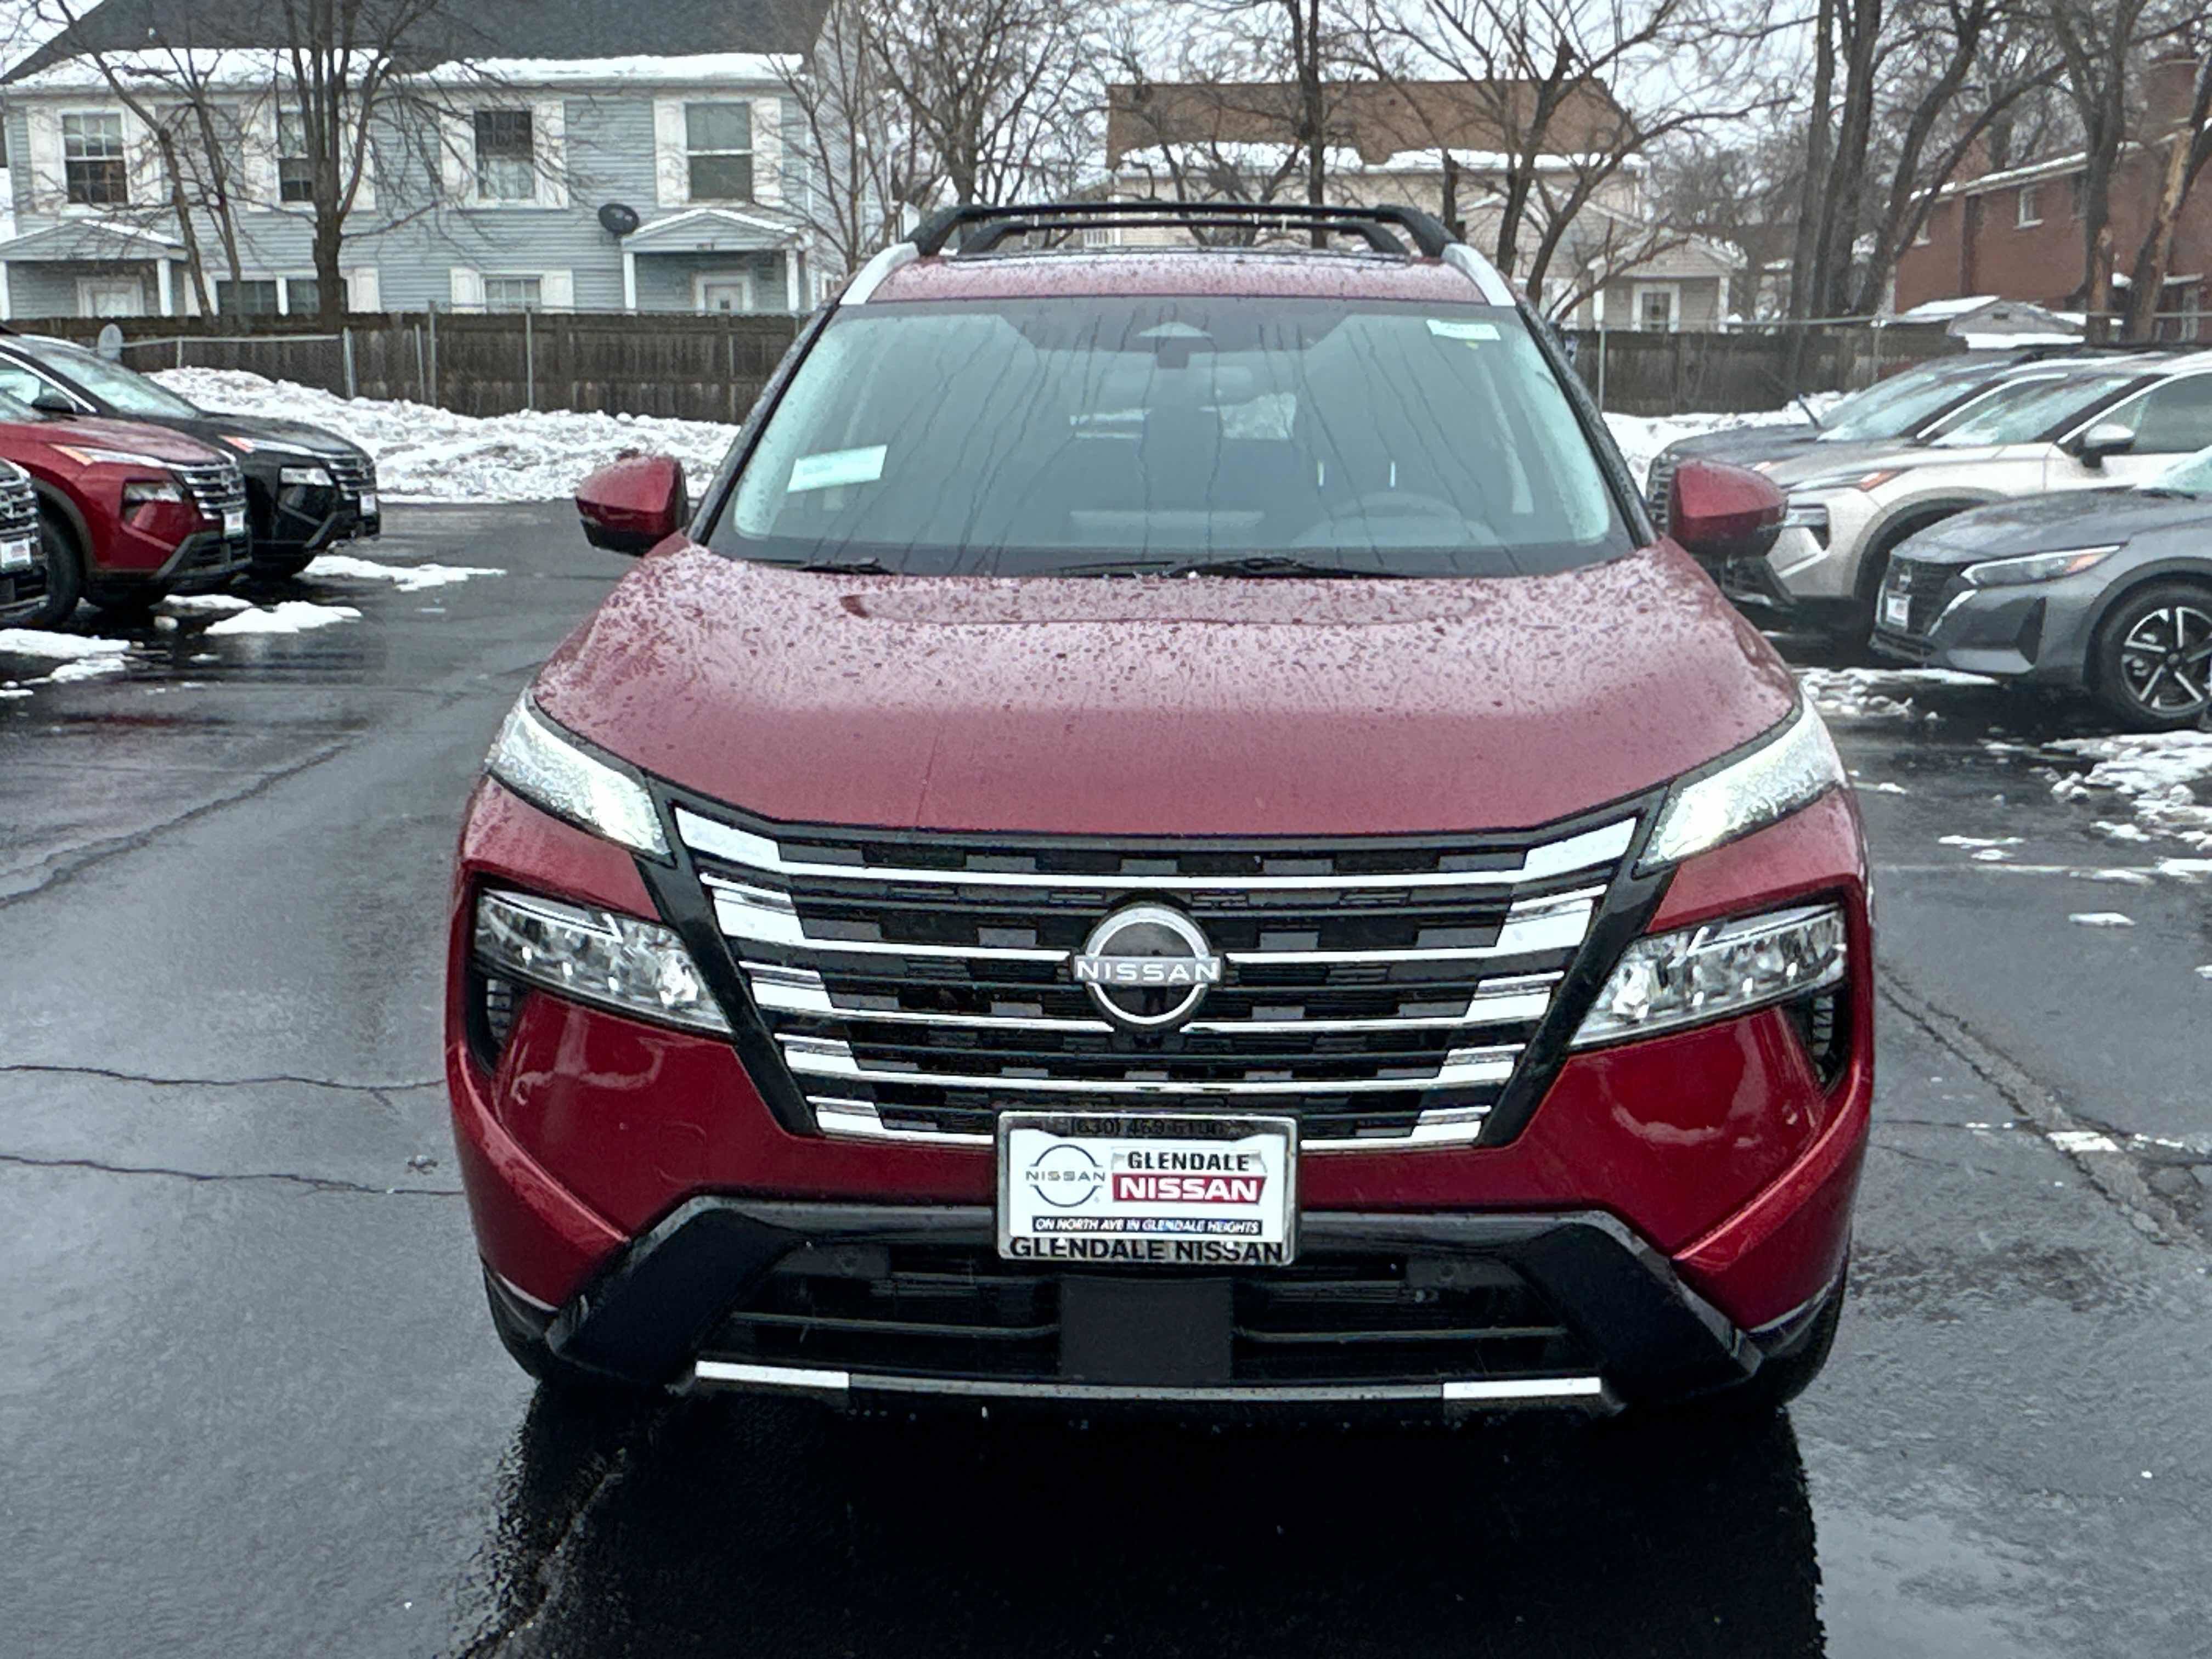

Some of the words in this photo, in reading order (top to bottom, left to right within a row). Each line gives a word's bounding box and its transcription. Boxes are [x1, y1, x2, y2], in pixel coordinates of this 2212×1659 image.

[1077, 961, 1216, 982] NISSAN
[1127, 1151, 1249, 1171] GLENDALE
[1026, 1171, 1105, 1182] NISSAN
[1120, 1177, 1257, 1201] NISSAN
[1035, 1218, 1054, 1230] ON
[1057, 1218, 1098, 1231] NORTH
[1101, 1220, 1124, 1231] AVE
[1126, 1220, 1139, 1231] IN
[1142, 1220, 1205, 1232] GLENDALE
[1207, 1221, 1259, 1233] HEIGHTS
[1010, 1237, 1164, 1259] GLENDALE
[1176, 1240, 1283, 1261] NISSAN
